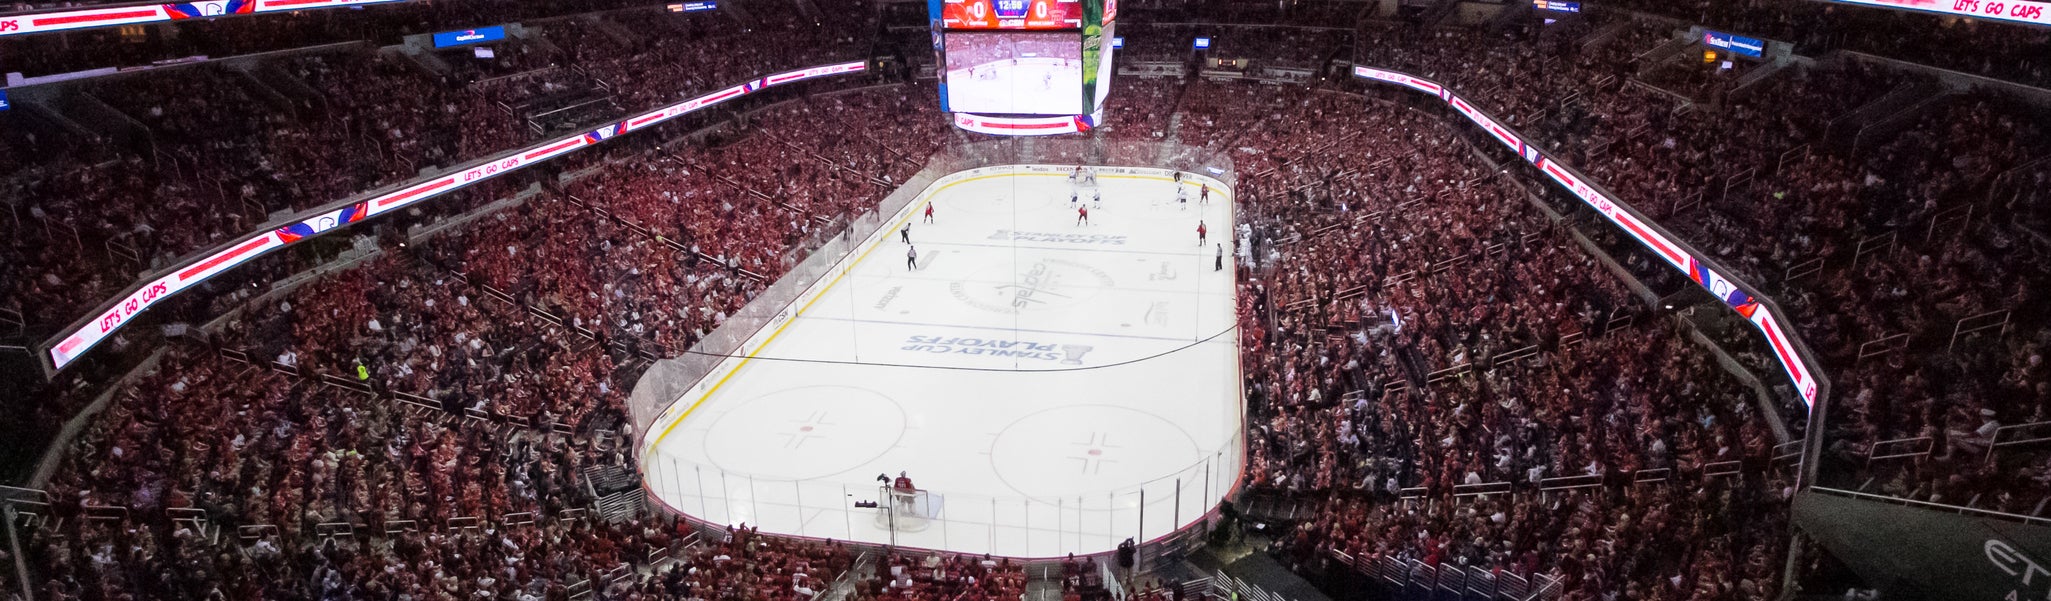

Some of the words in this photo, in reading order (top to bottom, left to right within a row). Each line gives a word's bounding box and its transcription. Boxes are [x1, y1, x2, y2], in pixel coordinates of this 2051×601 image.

[973, 1, 984, 18] 0
[1036, 1, 1047, 18] 0
[1953, 0, 1980, 12] LET'S
[1985, 2, 2004, 15] GO
[2010, 5, 2043, 19] CAPS
[486, 164, 498, 175] GO
[501, 158, 519, 169] CAPS
[100, 309, 121, 333] LET'S
[125, 298, 138, 315] GO
[142, 281, 167, 303] CAPS
[901, 344, 953, 353] CUP
[906, 335, 1058, 351] PLAYOFFS
